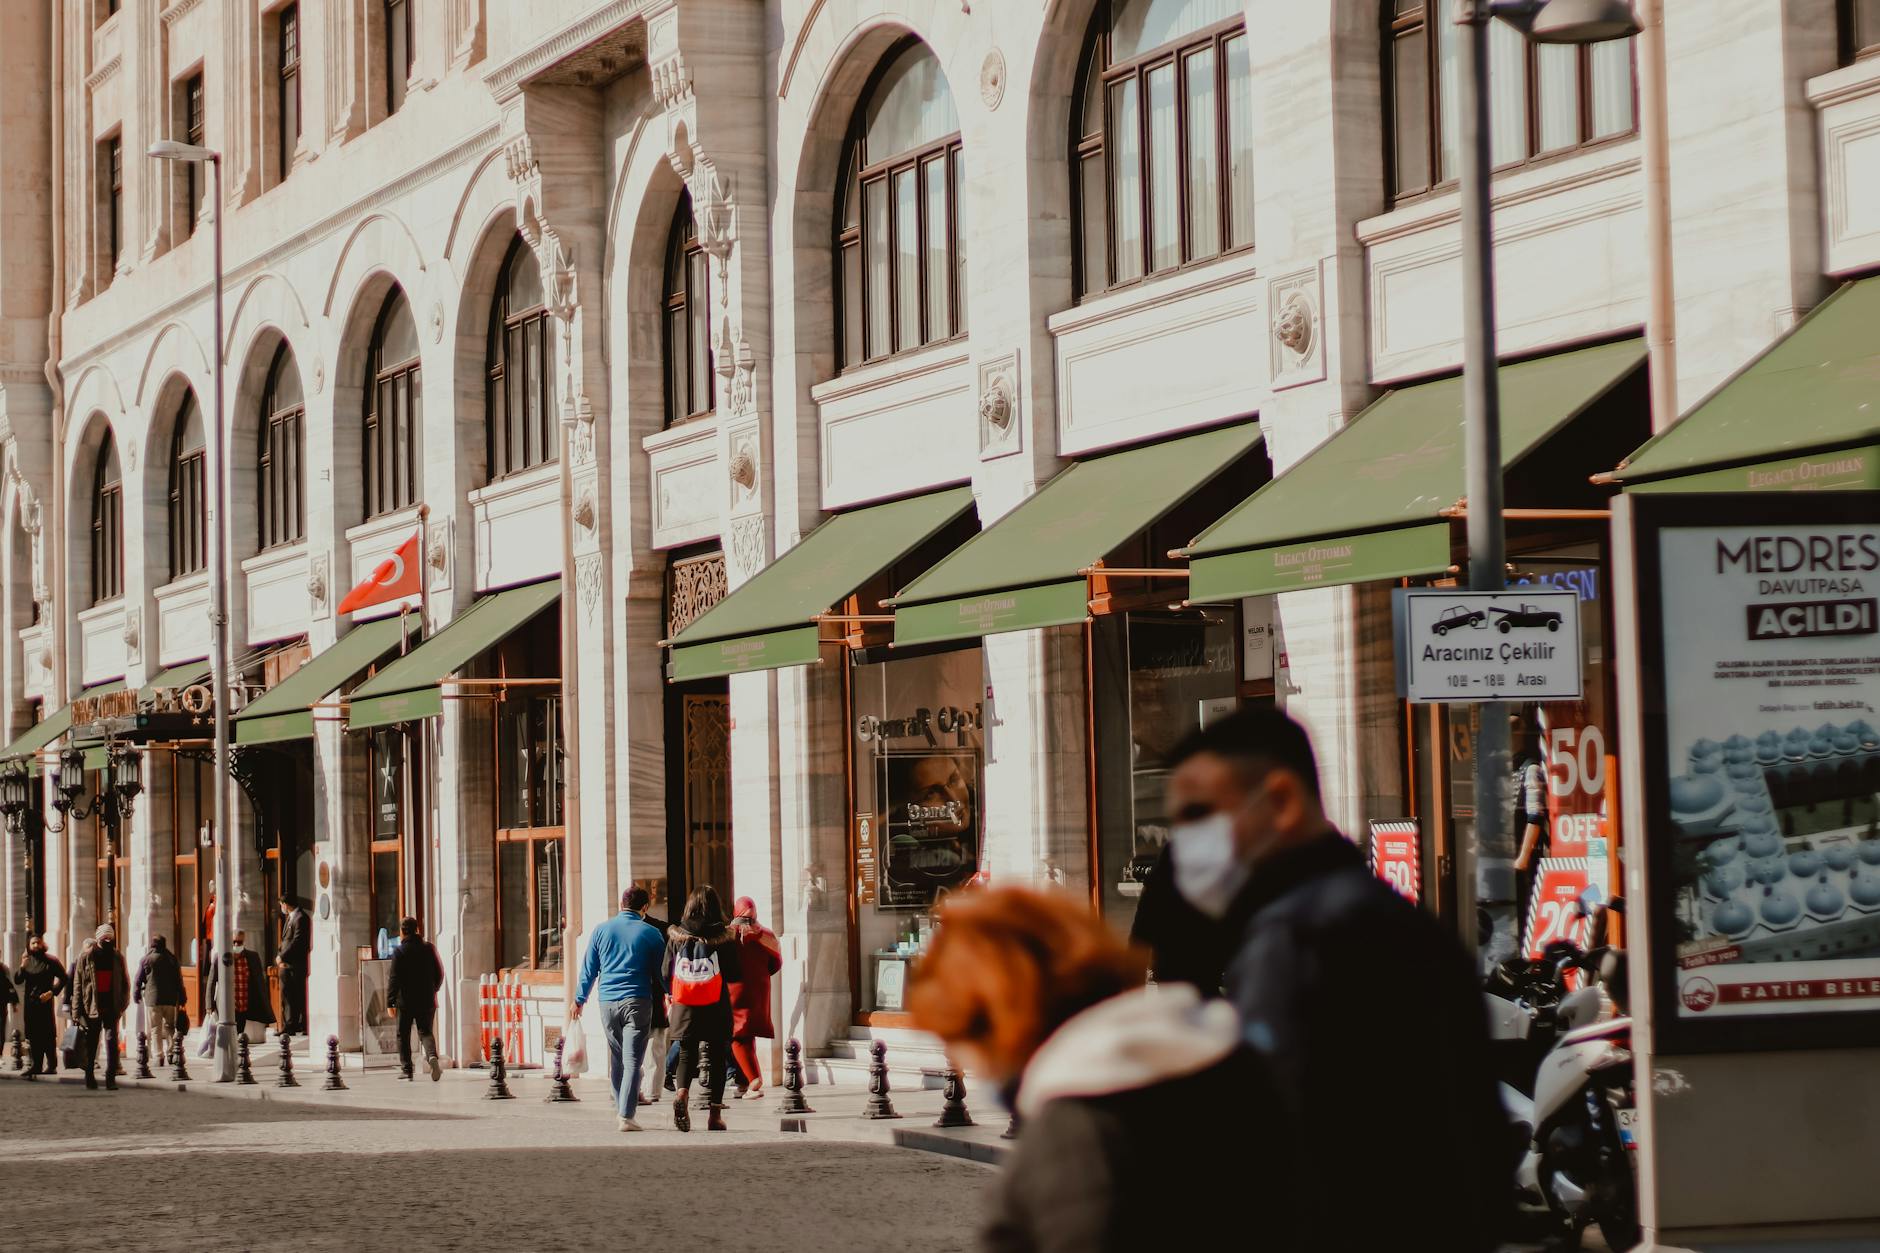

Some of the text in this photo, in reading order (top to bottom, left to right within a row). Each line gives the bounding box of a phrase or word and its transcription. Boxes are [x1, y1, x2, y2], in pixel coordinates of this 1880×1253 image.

[1758, 577, 1865, 597] DAVUTPAŞA
[1755, 602, 1872, 637] AÇILDI
[1422, 642, 1556, 665] Aracınız Çekilir
[1516, 672, 1547, 686] Arası
[1551, 725, 1605, 797] 50
[1740, 982, 1810, 999] FATİH
